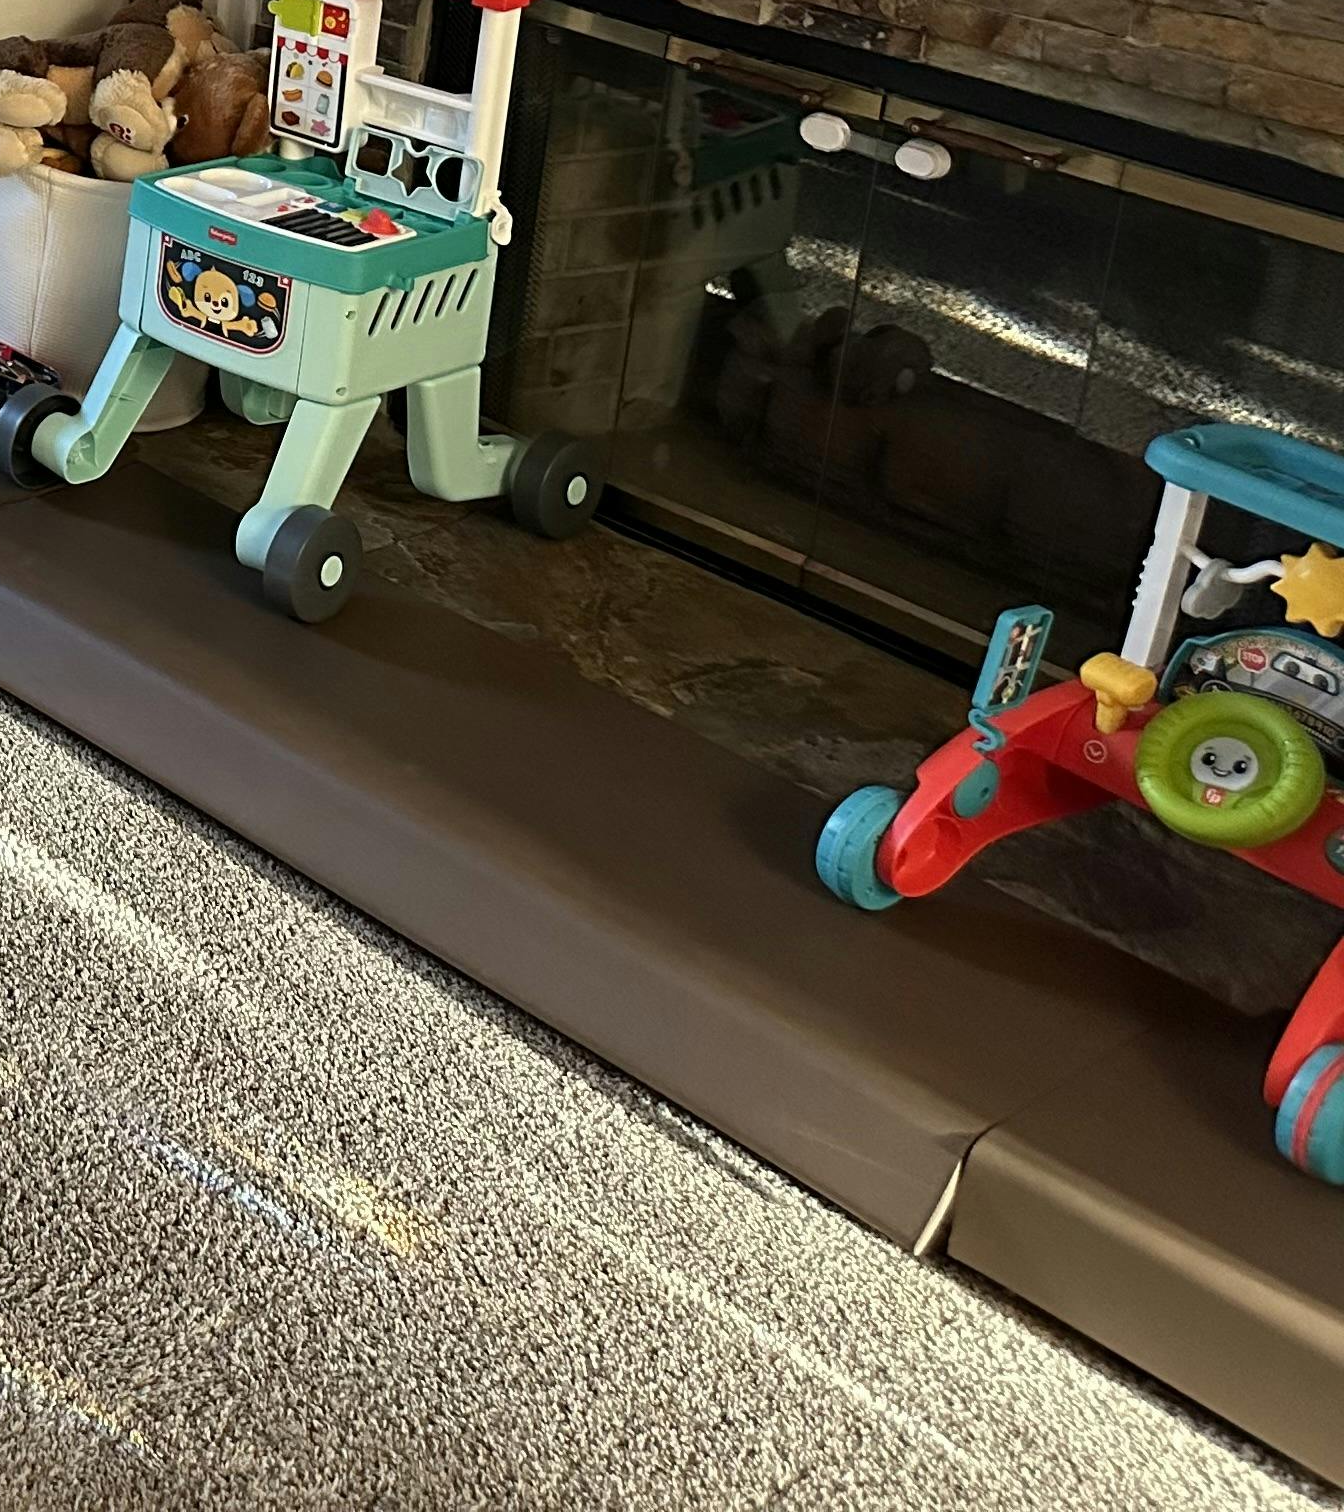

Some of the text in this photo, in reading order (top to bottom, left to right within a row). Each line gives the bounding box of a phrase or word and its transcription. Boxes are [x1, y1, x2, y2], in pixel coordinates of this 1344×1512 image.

[180, 249, 201, 263] ABC
[242, 270, 264, 287] 123
[1242, 652, 1264, 663] STOP
